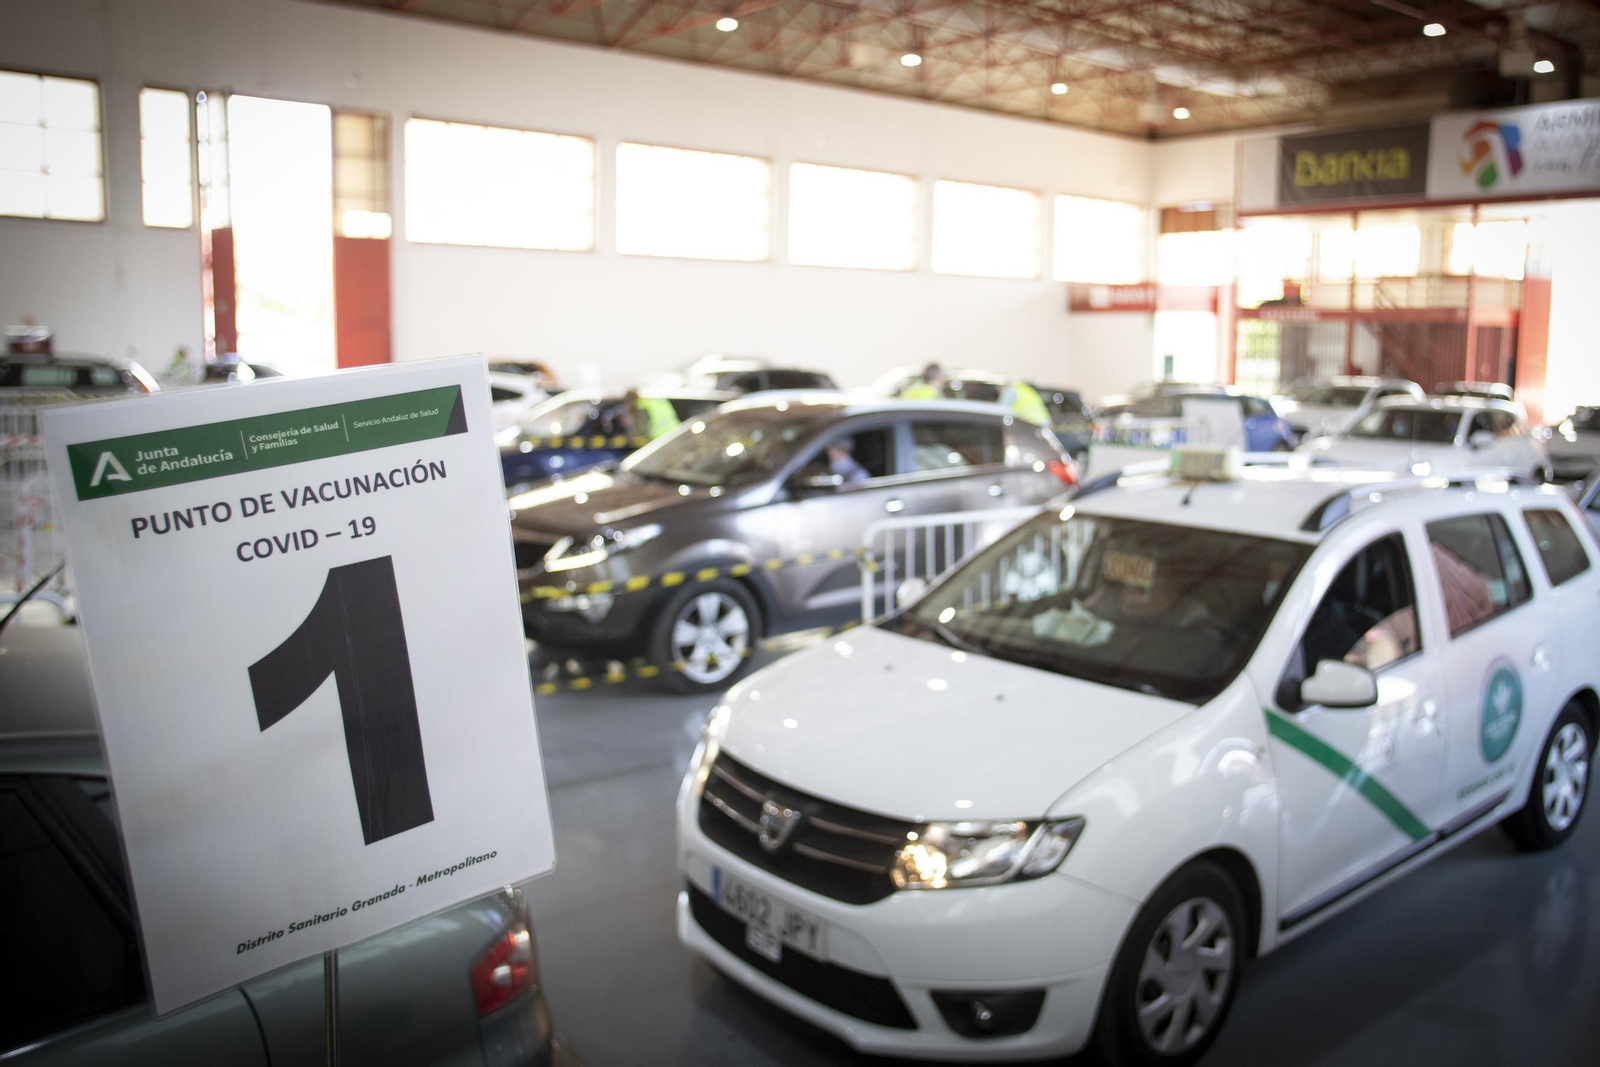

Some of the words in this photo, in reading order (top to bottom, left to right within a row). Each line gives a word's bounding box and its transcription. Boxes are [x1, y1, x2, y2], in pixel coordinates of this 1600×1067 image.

[1294, 147, 1411, 186] Bankia
[249, 427, 299, 443] Consejería
[300, 425, 312, 435] de
[313, 421, 339, 433] Salud
[353, 418, 381, 429] Servicio
[381, 414, 409, 424] Andaluz
[409, 411, 419, 419] de
[420, 408, 439, 418] Salud
[135, 446, 179, 462] Junta
[252, 445, 258, 453] y
[259, 437, 298, 451] Familias
[137, 463, 157, 475] de
[160, 449, 234, 472] Andalucía
[131, 502, 232, 539] PUNTO
[240, 493, 275, 518] DE
[281, 459, 447, 509] VACUNACIÓN
[236, 528, 319, 562] COVID
[348, 516, 377, 539] 19
[247, 555, 435, 845] 1
[236, 928, 285, 955] Distrito
[288, 906, 348, 934] Sanitario
[351, 884, 406, 912] Granada
[416, 850, 498, 886] Metropolitano
